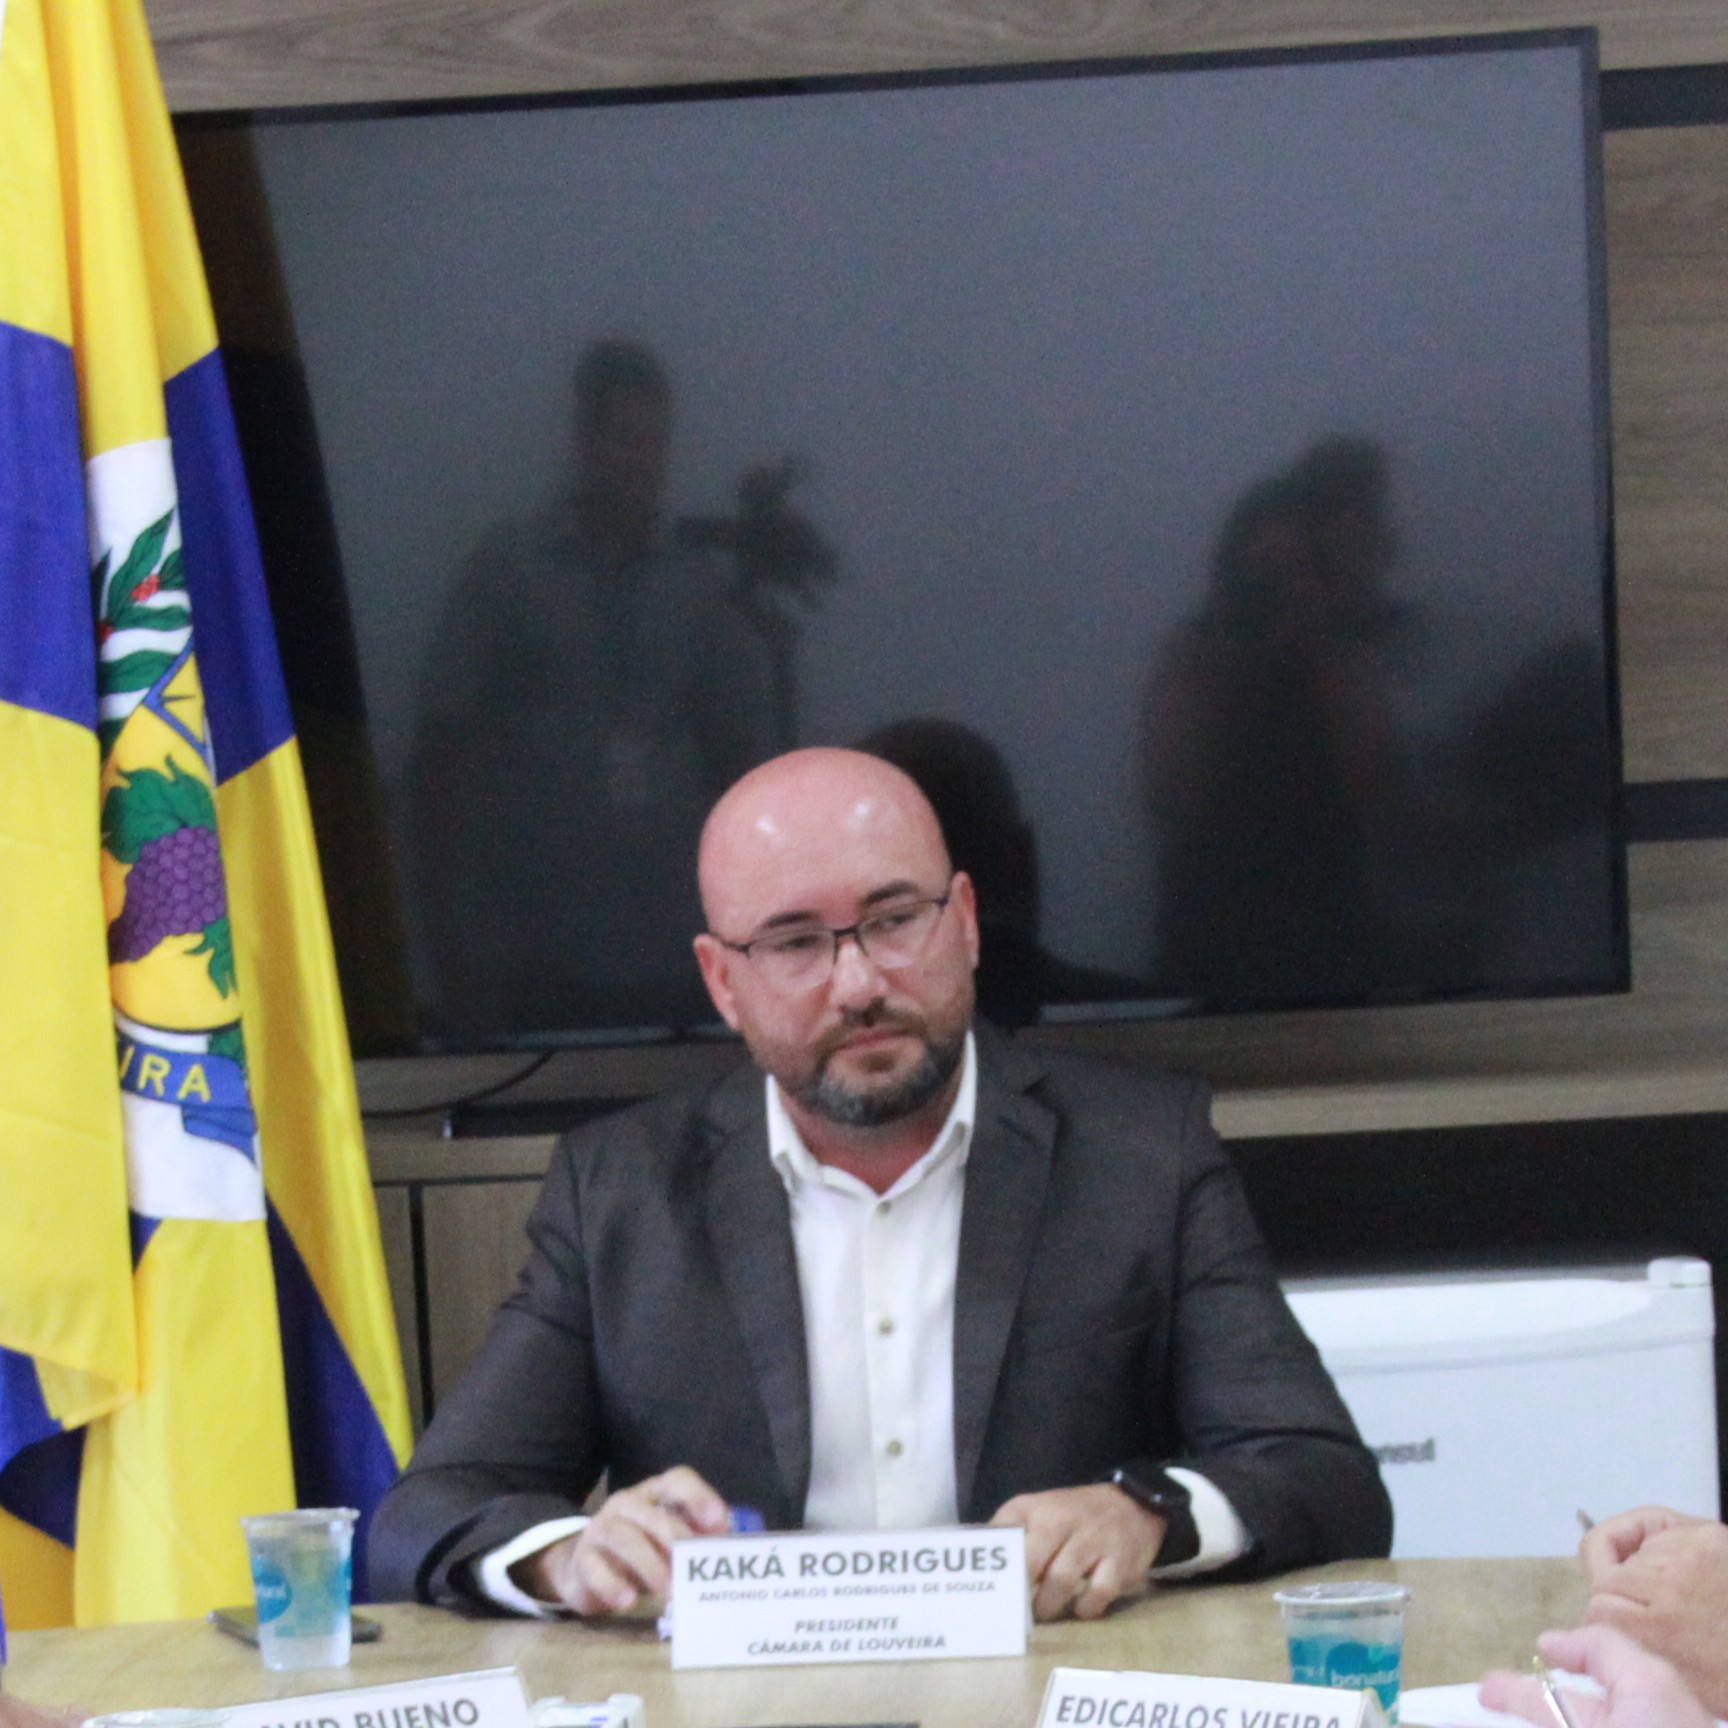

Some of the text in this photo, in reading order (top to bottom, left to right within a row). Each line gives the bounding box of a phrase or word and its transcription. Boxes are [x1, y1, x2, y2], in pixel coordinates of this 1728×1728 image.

[688, 1546, 1009, 1582] KAKÁ RODRIGUES
[773, 1587, 828, 1600] CARLOS
[834, 1583, 917, 1598] RODRIGUES
[922, 1583, 941, 1595] DE
[945, 1580, 995, 1593] SOUZA
[794, 1617, 899, 1634] PRESIDENTE
[747, 1635, 947, 1656] CÂMARA DE LOUVEIRA
